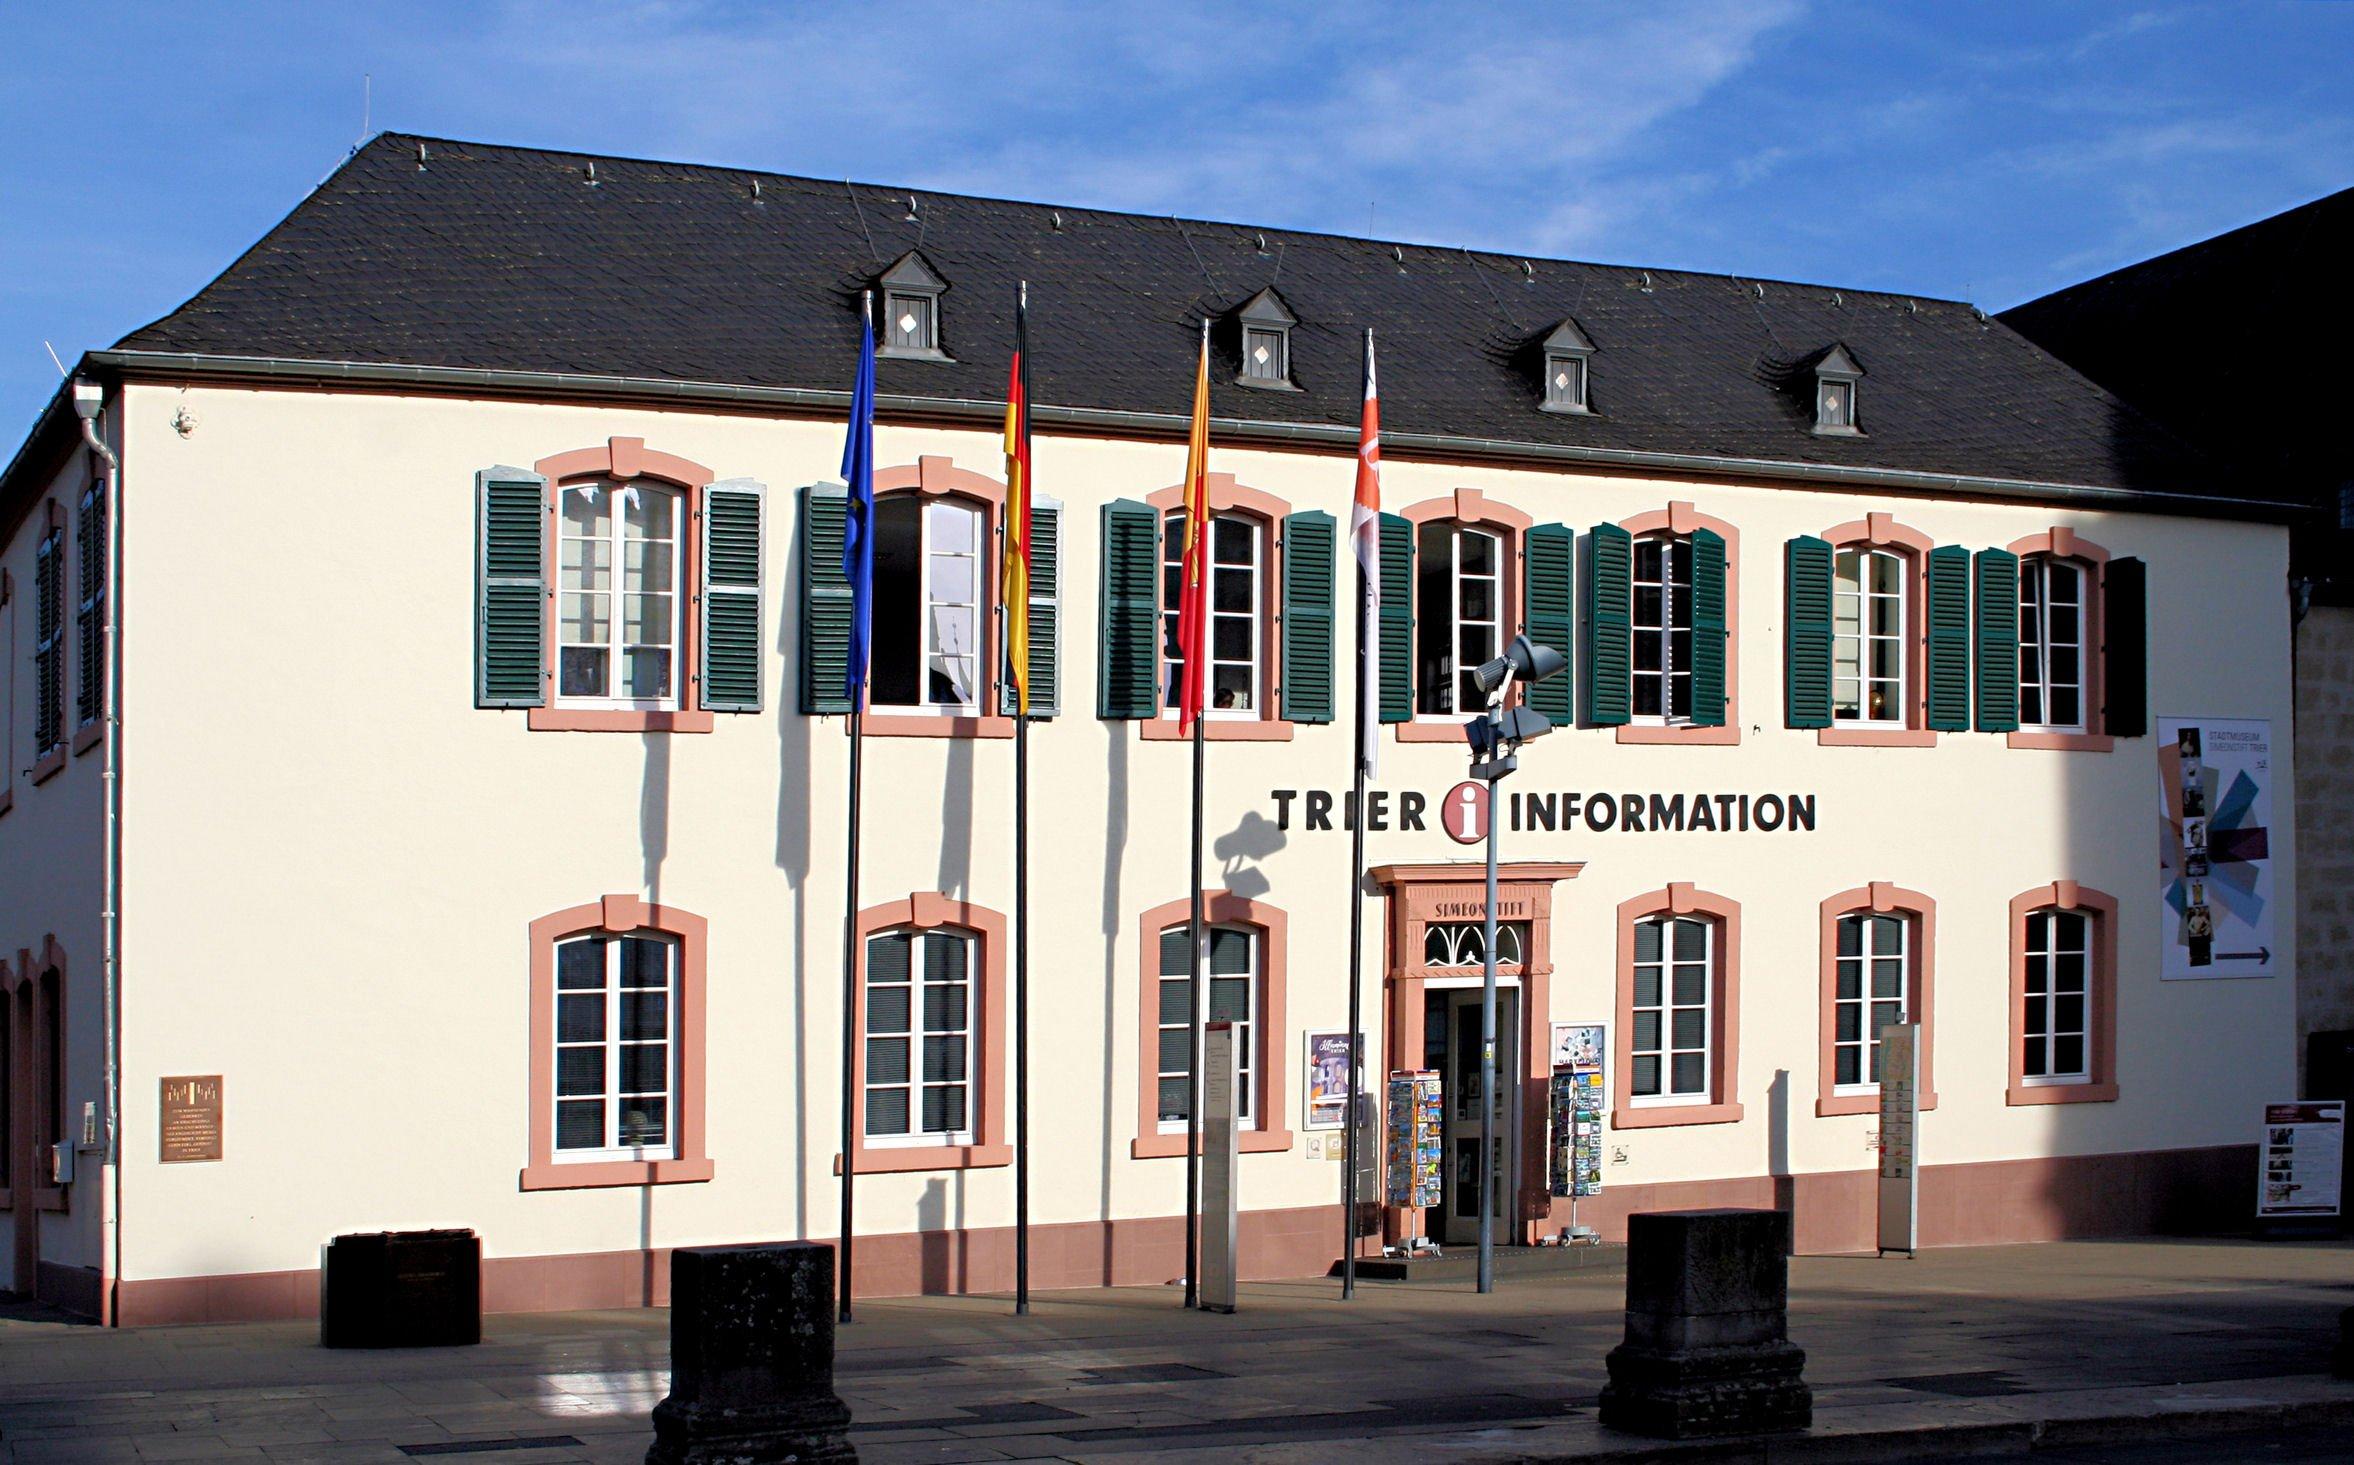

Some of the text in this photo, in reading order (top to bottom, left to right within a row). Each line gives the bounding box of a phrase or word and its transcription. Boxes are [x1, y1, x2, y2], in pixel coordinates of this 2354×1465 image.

[2209, 731, 2260, 741] STADTMUSEUM
[2249, 743, 2268, 753] TRIER
[1271, 786, 1816, 838] TRIER i INFORMATION
[1435, 902, 1524, 917] SIMEONTIFT
